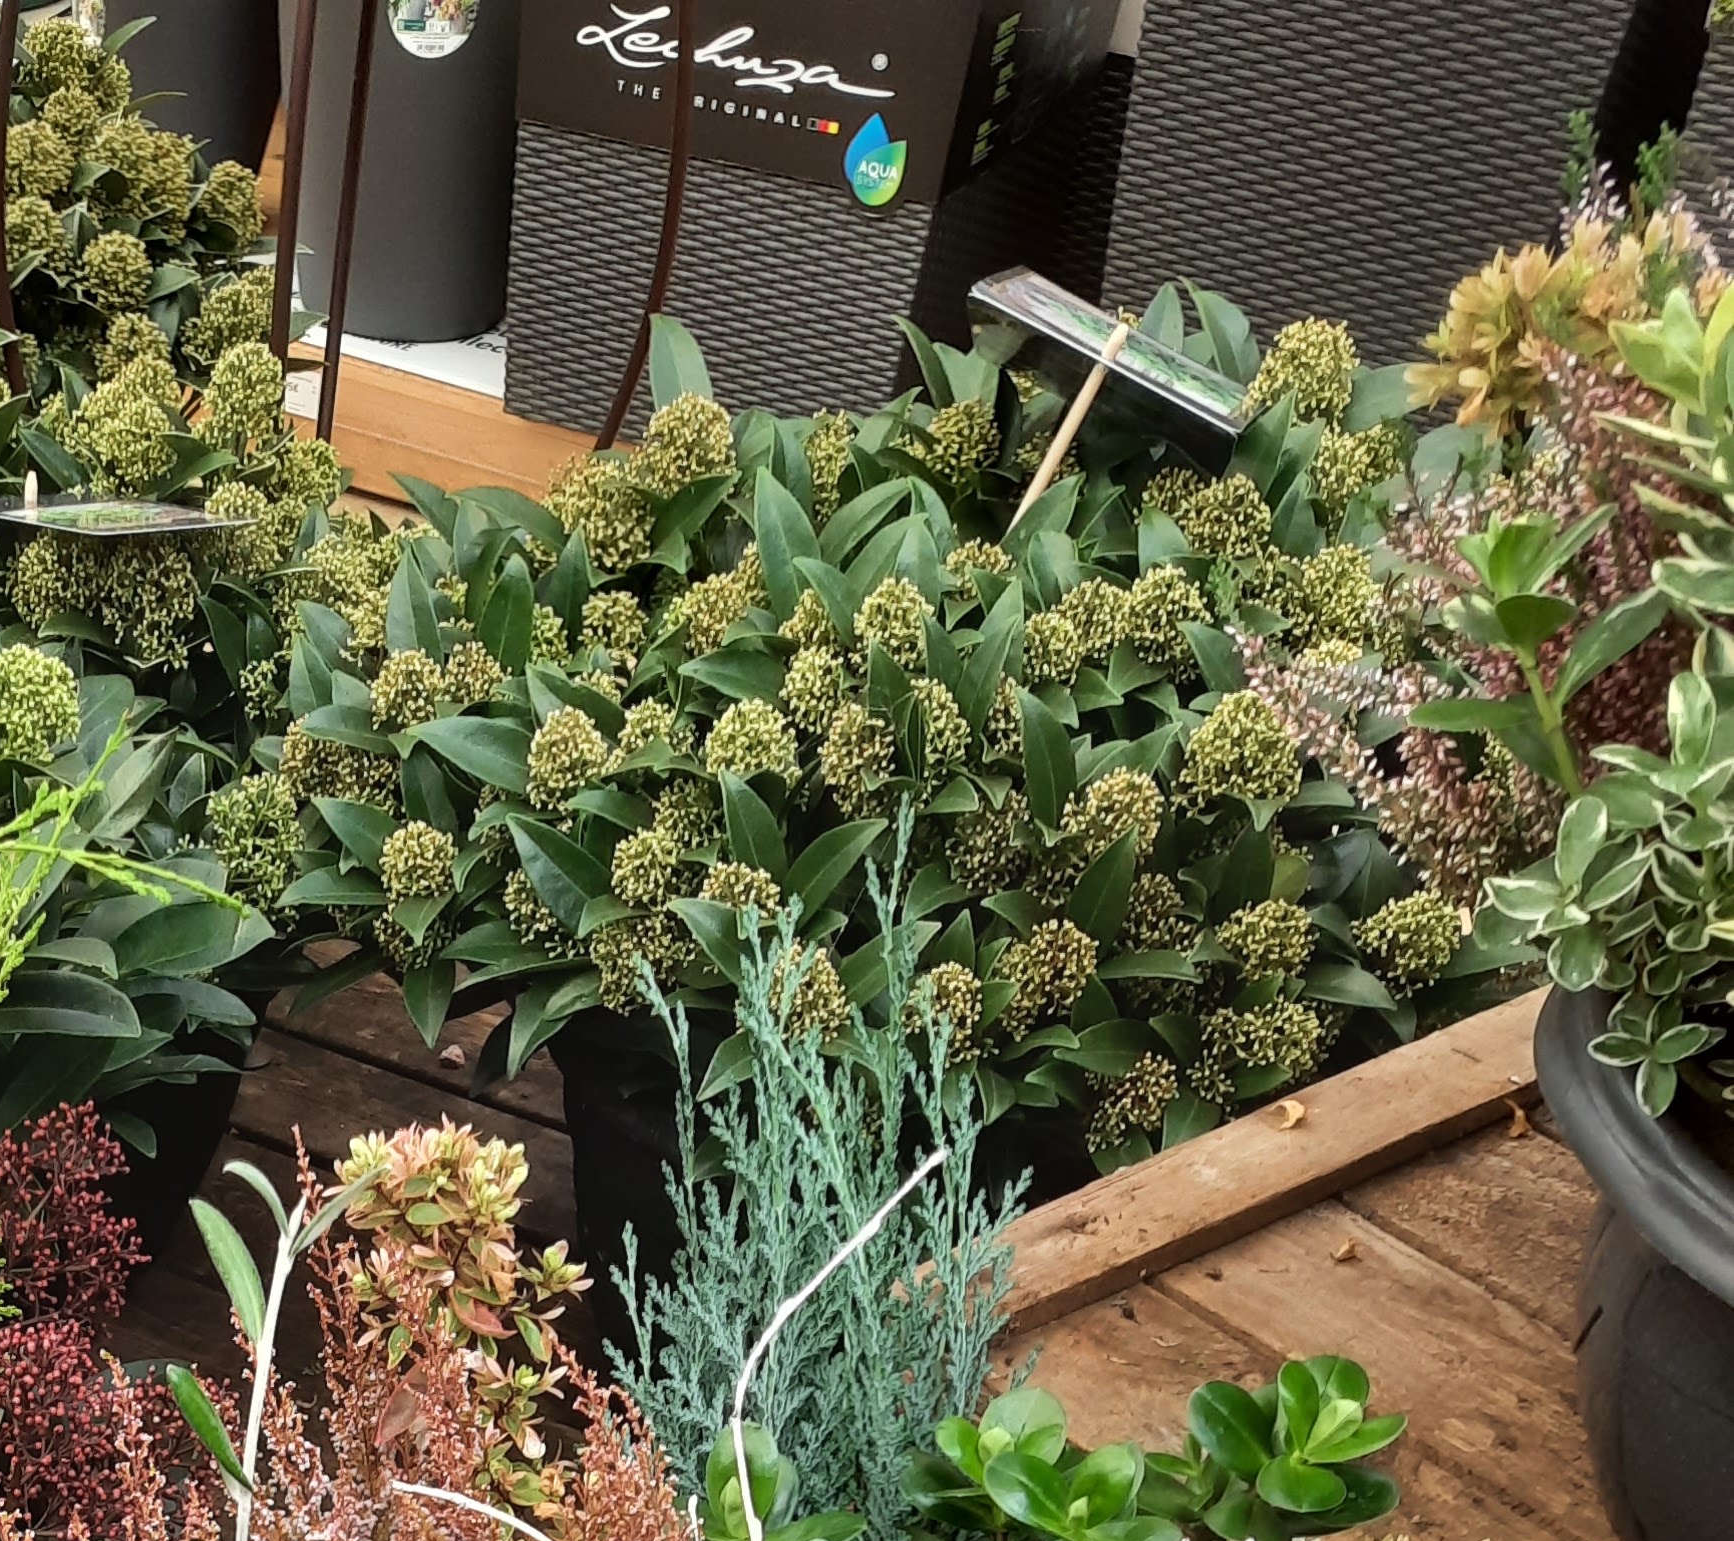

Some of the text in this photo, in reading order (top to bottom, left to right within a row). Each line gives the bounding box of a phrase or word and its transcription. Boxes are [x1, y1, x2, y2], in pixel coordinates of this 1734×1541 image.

[576, 3, 896, 98] Lechuza
[617, 79, 801, 127] THE RIGINAL
[858, 159, 897, 179] AQUA
